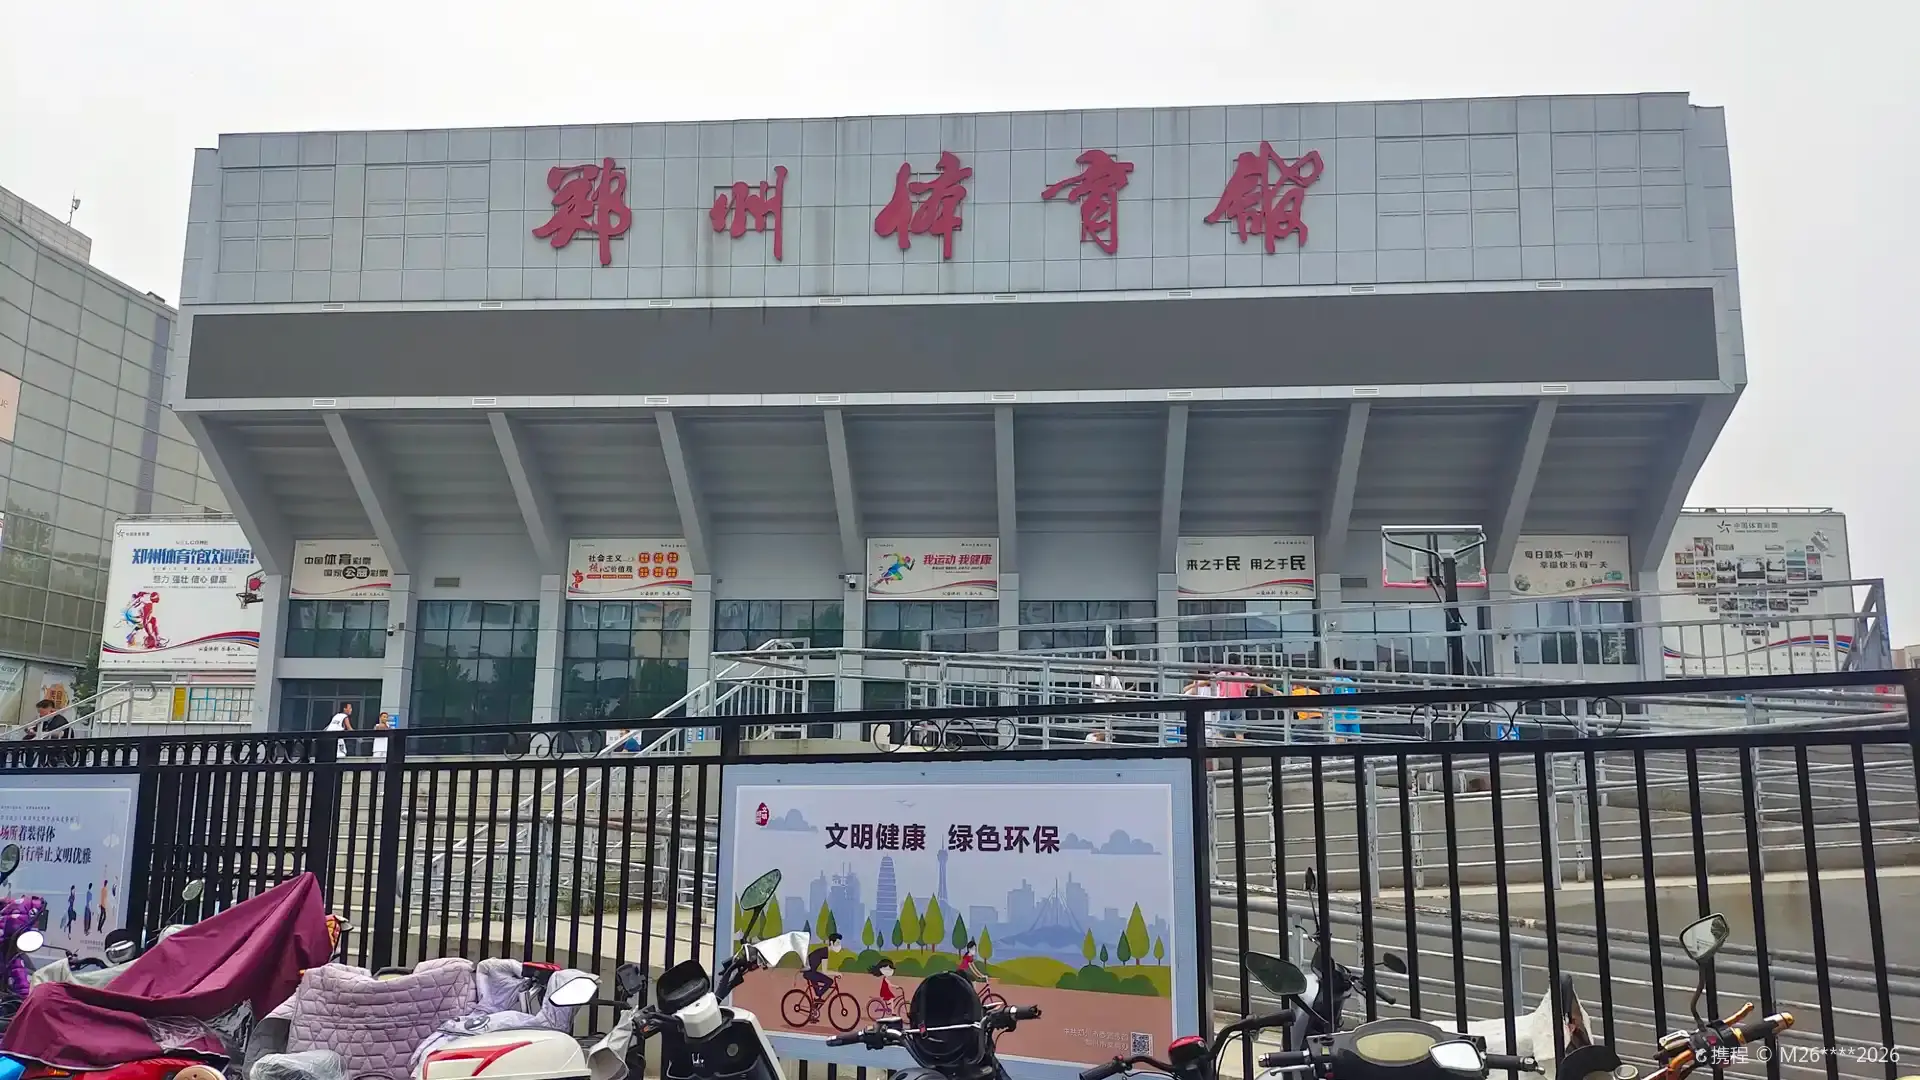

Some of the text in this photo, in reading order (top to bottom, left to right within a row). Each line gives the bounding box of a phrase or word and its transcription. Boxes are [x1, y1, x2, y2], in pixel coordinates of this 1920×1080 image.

[304, 553, 372, 565] 中国体育彩票
[588, 554, 622, 562] 社会主义
[923, 554, 993, 566] 我运动 我健康
[1525, 550, 1593, 559] 每日锻炼一小时
[1187, 555, 1306, 571] 来之于民 用之于民
[1540, 561, 1608, 569] 幸福快乐每一天
[825, 823, 1060, 854] 文明健康 绿色环保
